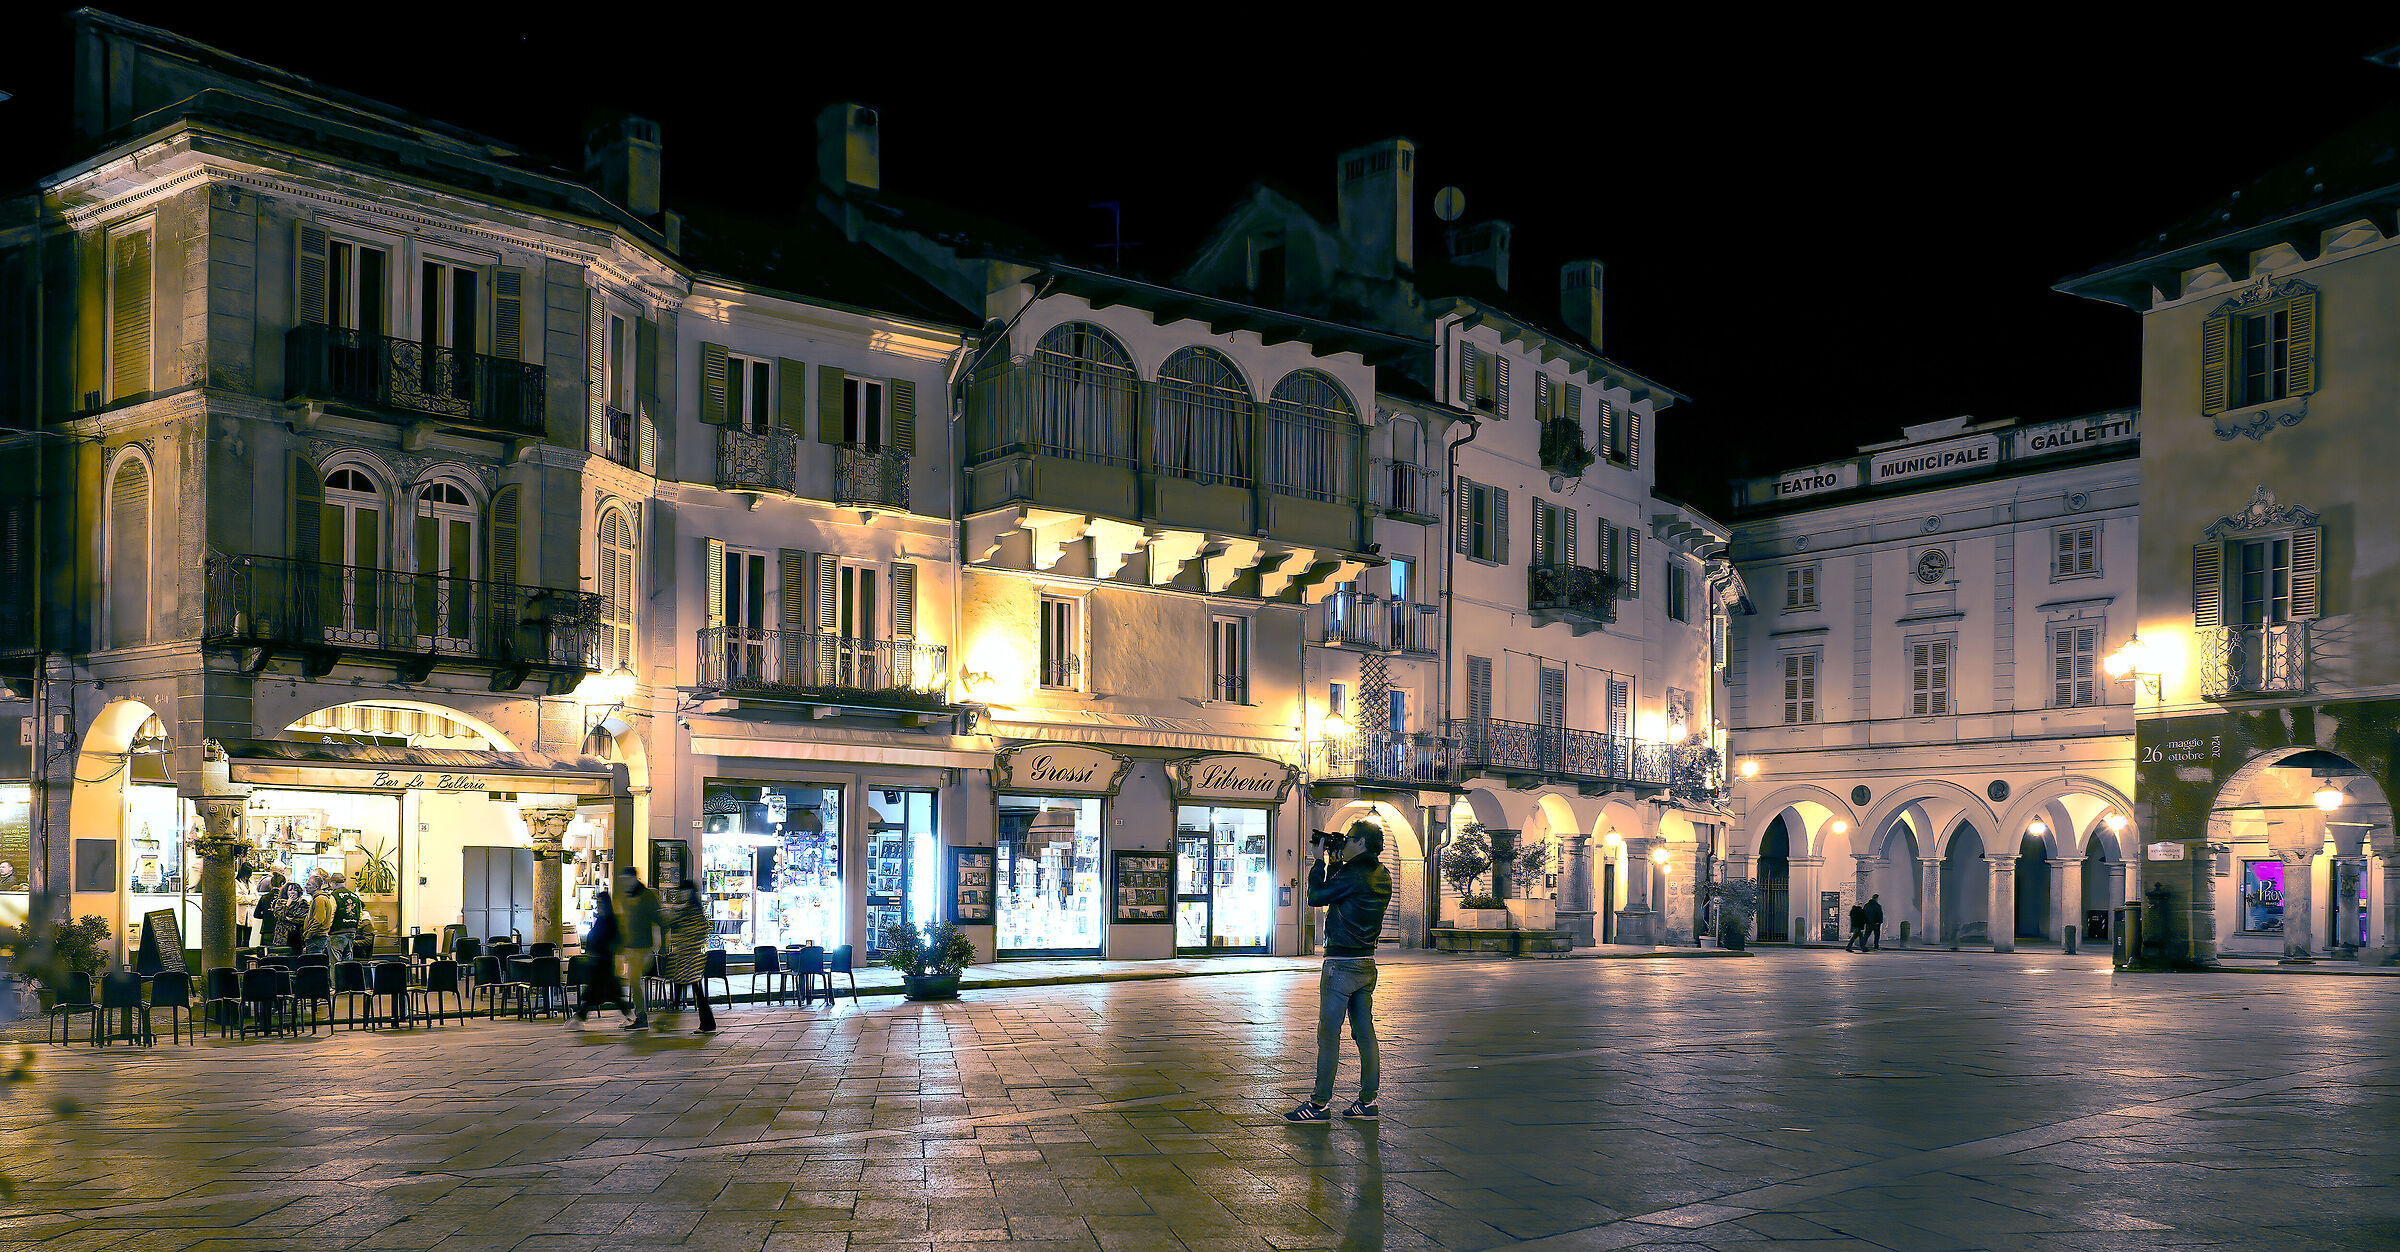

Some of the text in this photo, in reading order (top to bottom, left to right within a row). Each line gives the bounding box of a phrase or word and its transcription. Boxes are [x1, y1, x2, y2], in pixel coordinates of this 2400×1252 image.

[1771, 420, 2131, 496] TEATRO MUNICIPALE GALLETTI
[2141, 738, 2204, 763] 26 maggio
[2168, 751, 2205, 762] ottobre
[2211, 735, 2221, 758] 2024
[373, 772, 399, 787] Bar
[1031, 755, 1098, 783] Grossi
[1197, 764, 1275, 792] Libreria
